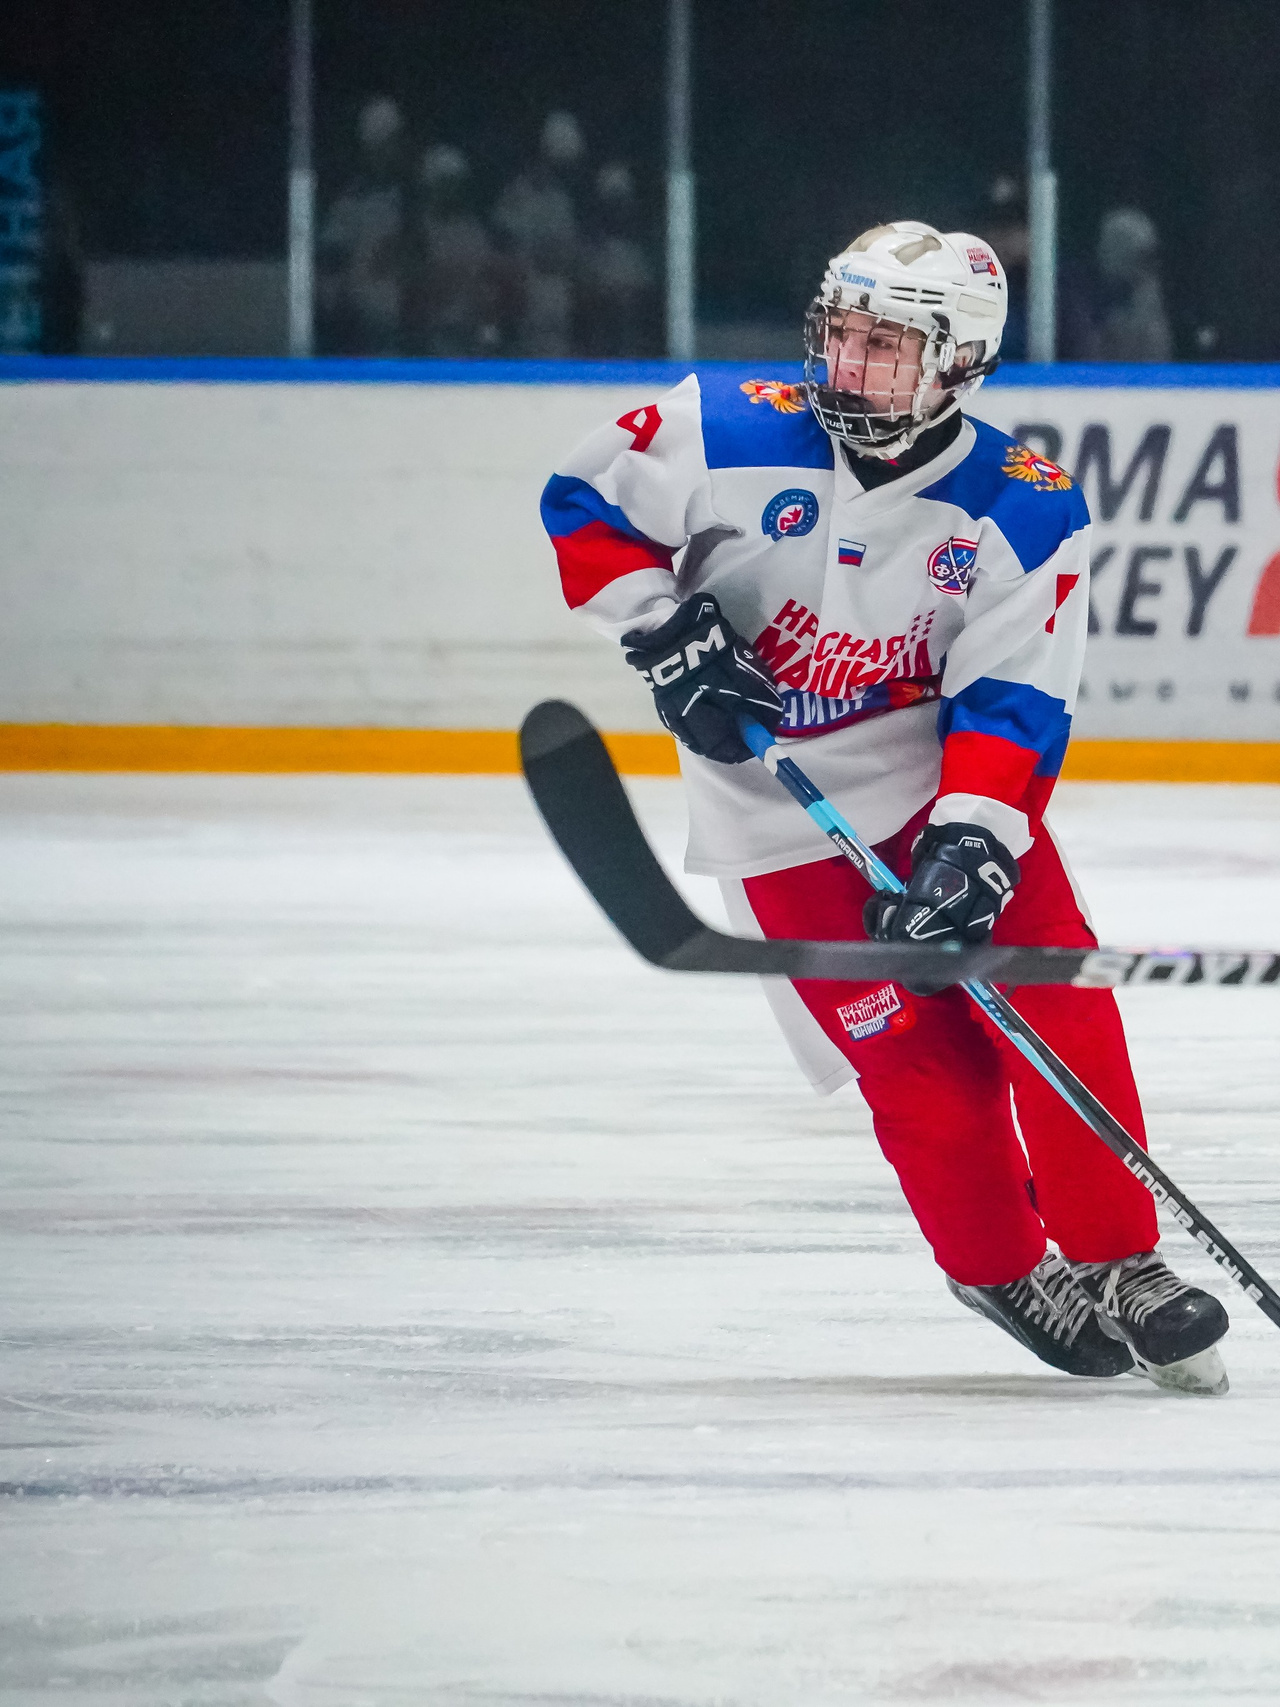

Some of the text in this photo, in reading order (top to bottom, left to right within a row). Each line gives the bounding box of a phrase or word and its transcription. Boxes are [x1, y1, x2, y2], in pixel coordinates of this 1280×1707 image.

[773, 598, 906, 666] КРСНАЯ
[832, 833, 864, 869] ARROW
[841, 992, 880, 1015] КРАСНАЯ
[843, 994, 898, 1028] МАШИНА
[852, 1018, 886, 1039] ЮНИОР
[1122, 1152, 1195, 1229] UNDER
